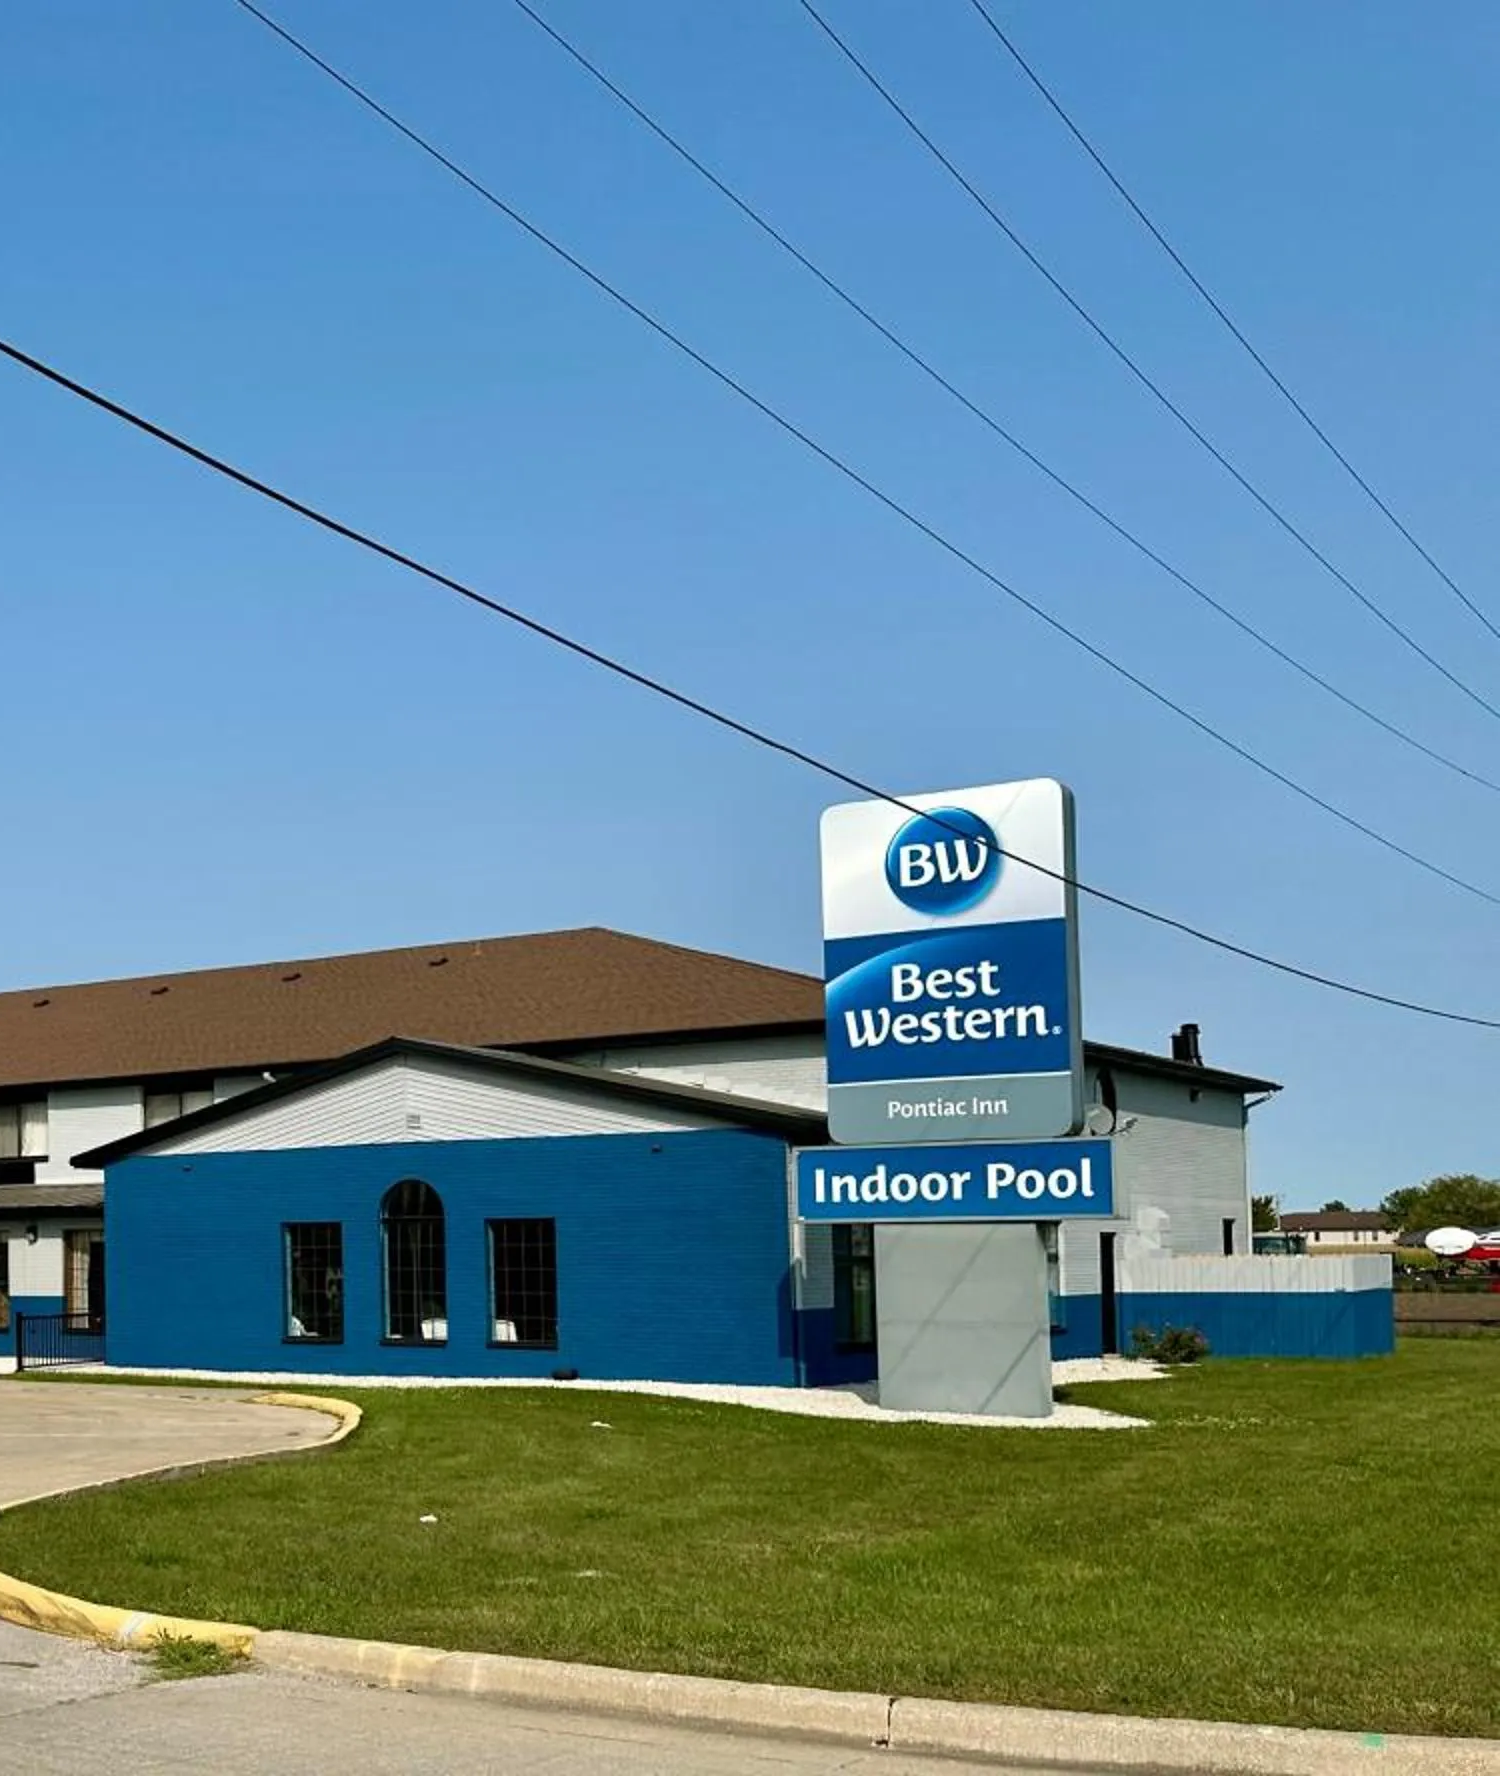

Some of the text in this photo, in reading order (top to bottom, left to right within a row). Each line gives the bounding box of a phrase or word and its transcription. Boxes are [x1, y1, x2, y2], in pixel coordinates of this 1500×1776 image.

[899, 835, 987, 888] BW
[891, 959, 1000, 1002] Best
[887, 1096, 1009, 1119] Pontiac Inn
[814, 1157, 1094, 1203] Indoor Pool
